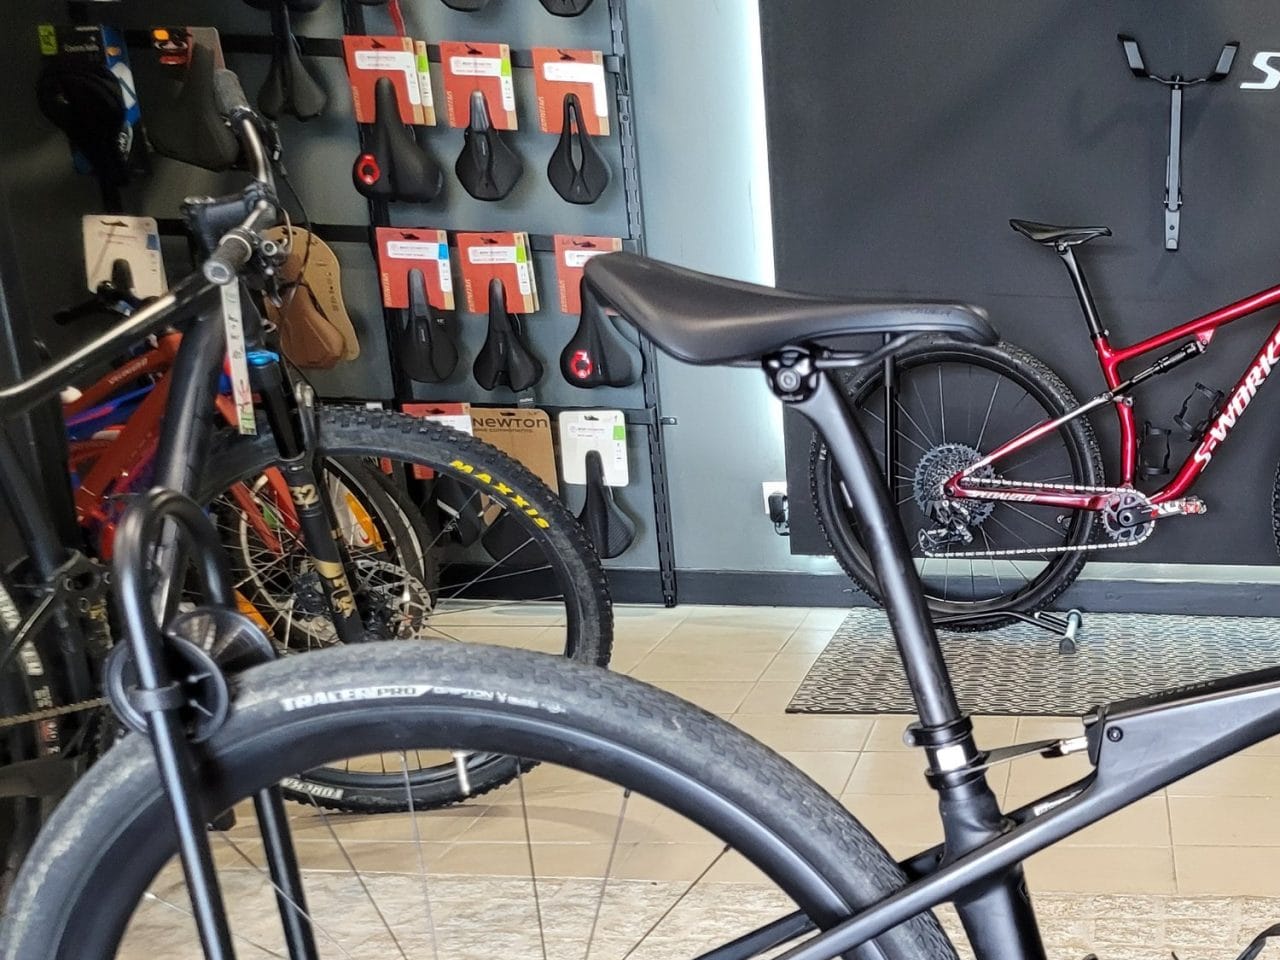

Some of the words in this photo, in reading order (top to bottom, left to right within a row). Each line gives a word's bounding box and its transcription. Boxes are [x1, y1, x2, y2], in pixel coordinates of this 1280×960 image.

[289, 484, 320, 506] 32
[448, 460, 550, 529] MAXXIS
[280, 688, 375, 711] TRACER
[376, 686, 417, 697] PRO
